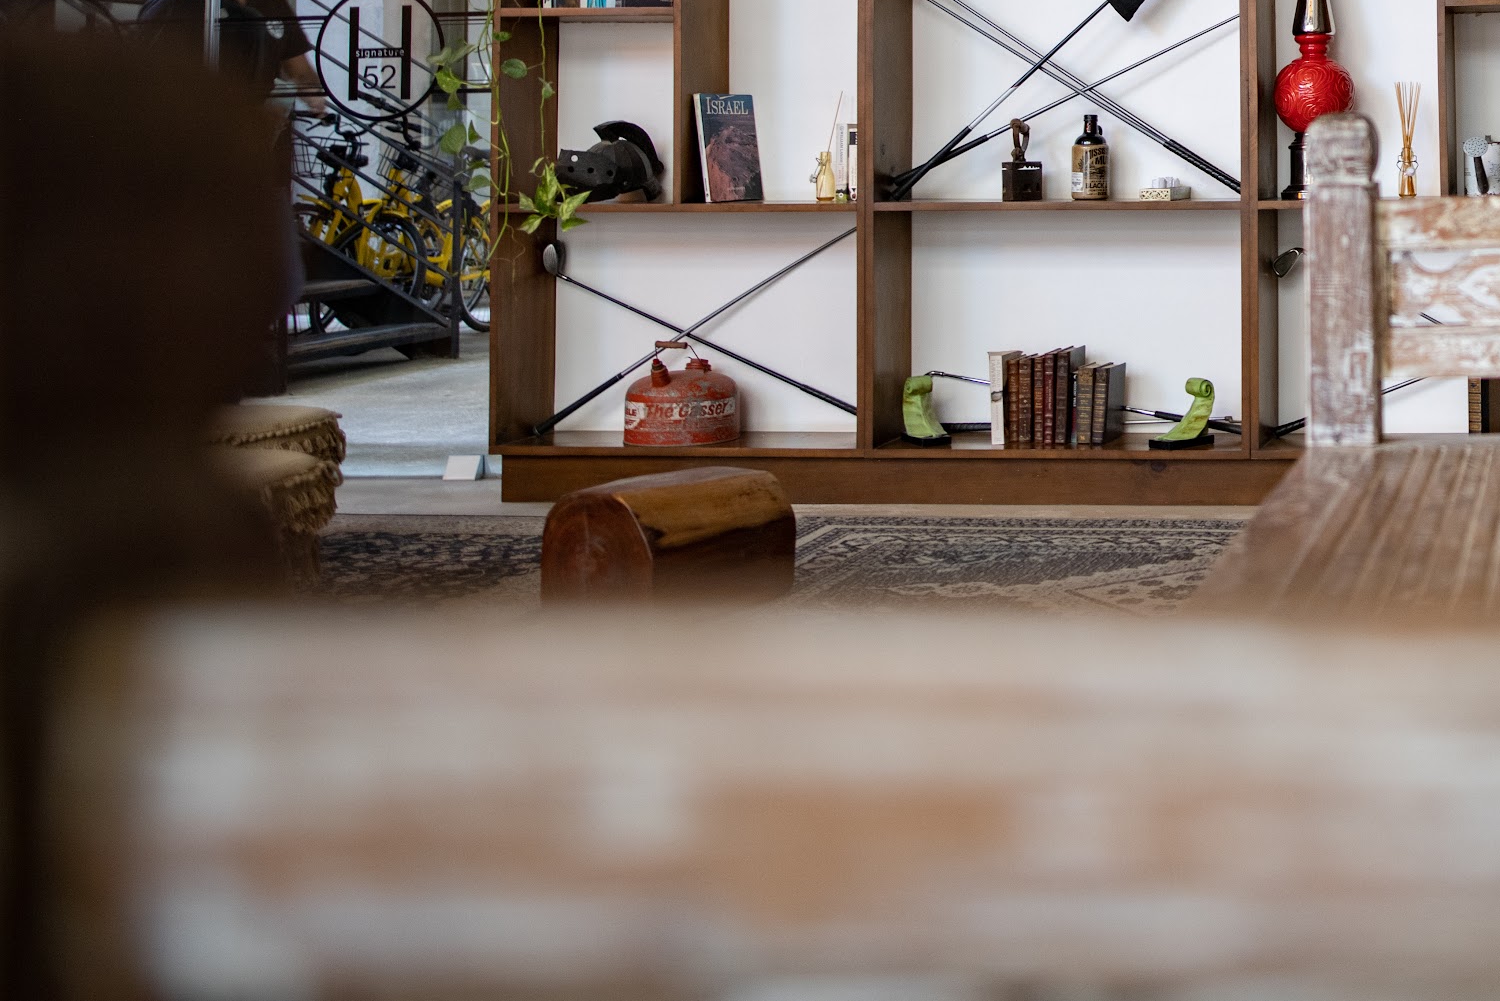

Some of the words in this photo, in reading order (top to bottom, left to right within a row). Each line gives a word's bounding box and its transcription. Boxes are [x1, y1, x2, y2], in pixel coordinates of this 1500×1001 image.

[355, 48, 405, 59] signature
[362, 65, 396, 89] 52
[706, 97, 749, 115] ISRAEL
[648, 403, 674, 418] The
[678, 402, 728, 418] Gsser
